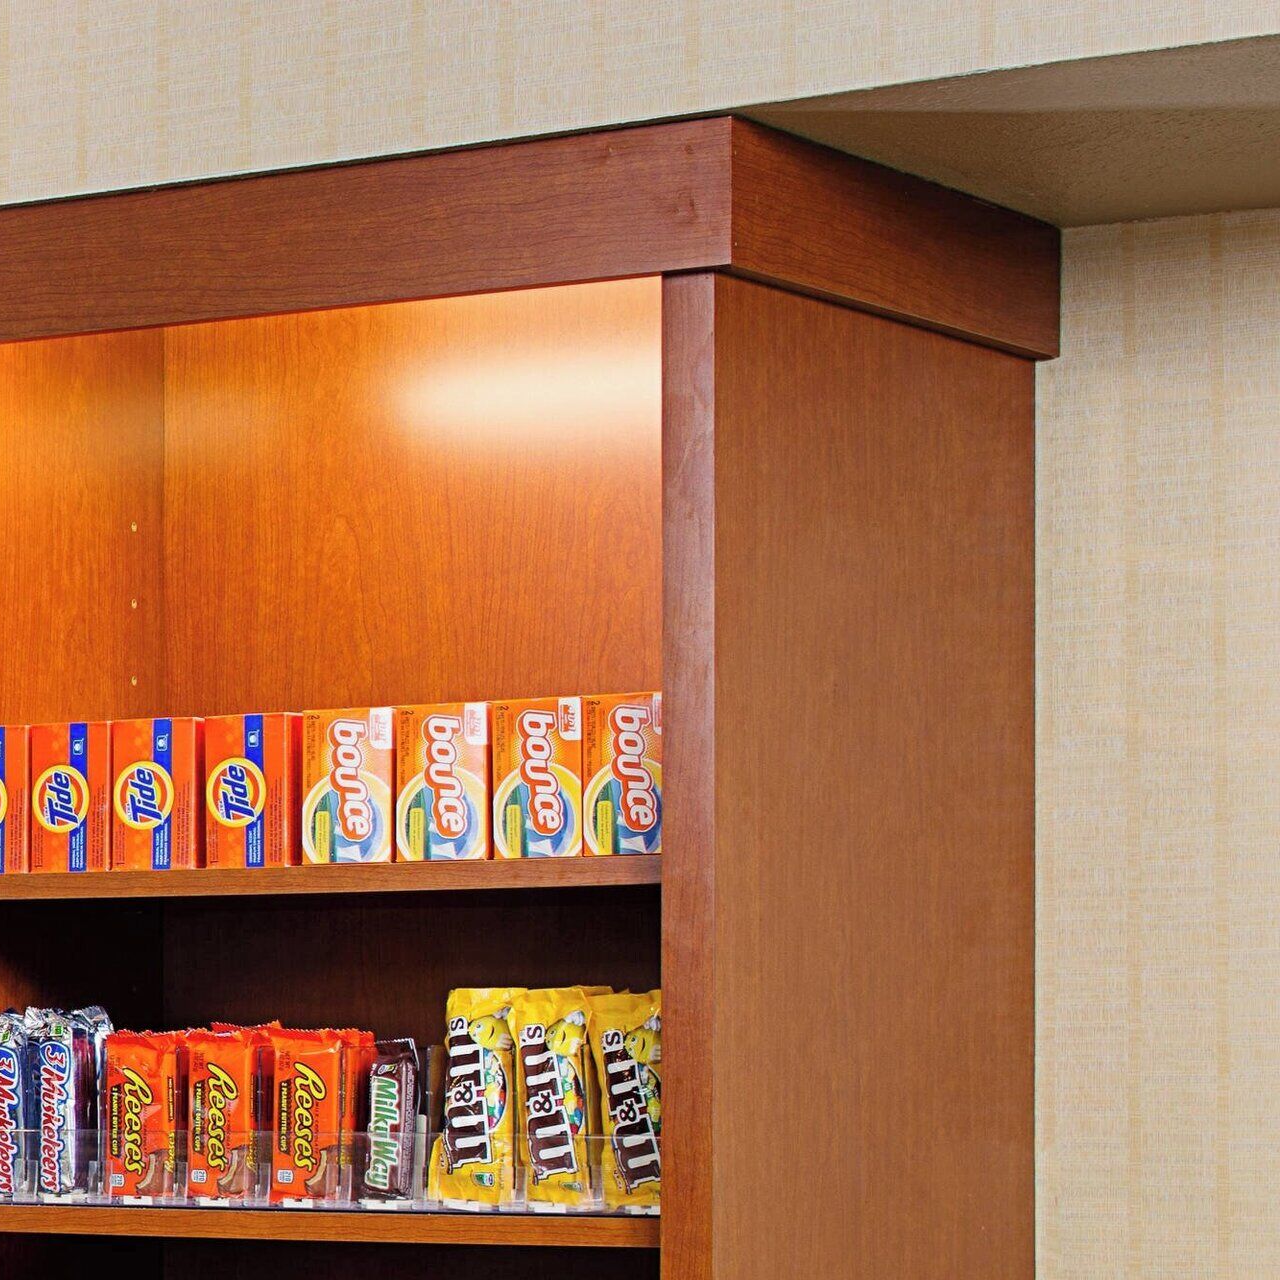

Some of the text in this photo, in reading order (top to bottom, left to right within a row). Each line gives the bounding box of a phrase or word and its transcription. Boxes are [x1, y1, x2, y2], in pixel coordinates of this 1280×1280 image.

[46, 771, 79, 826] Tide
[128, 767, 162, 824] Tide
[221, 763, 255, 822] Tide
[328, 719, 372, 841] bounce
[422, 715, 467, 838] bounce
[517, 710, 565, 835] bounce
[605, 704, 656, 831] bounce
[40, 1045, 67, 1192] 3 Musketeers
[123, 1066, 154, 1175] Reese's
[207, 1062, 238, 1172] Reese's
[294, 1062, 326, 1172] Reese's
[366, 1077, 398, 1188] Milky Way
